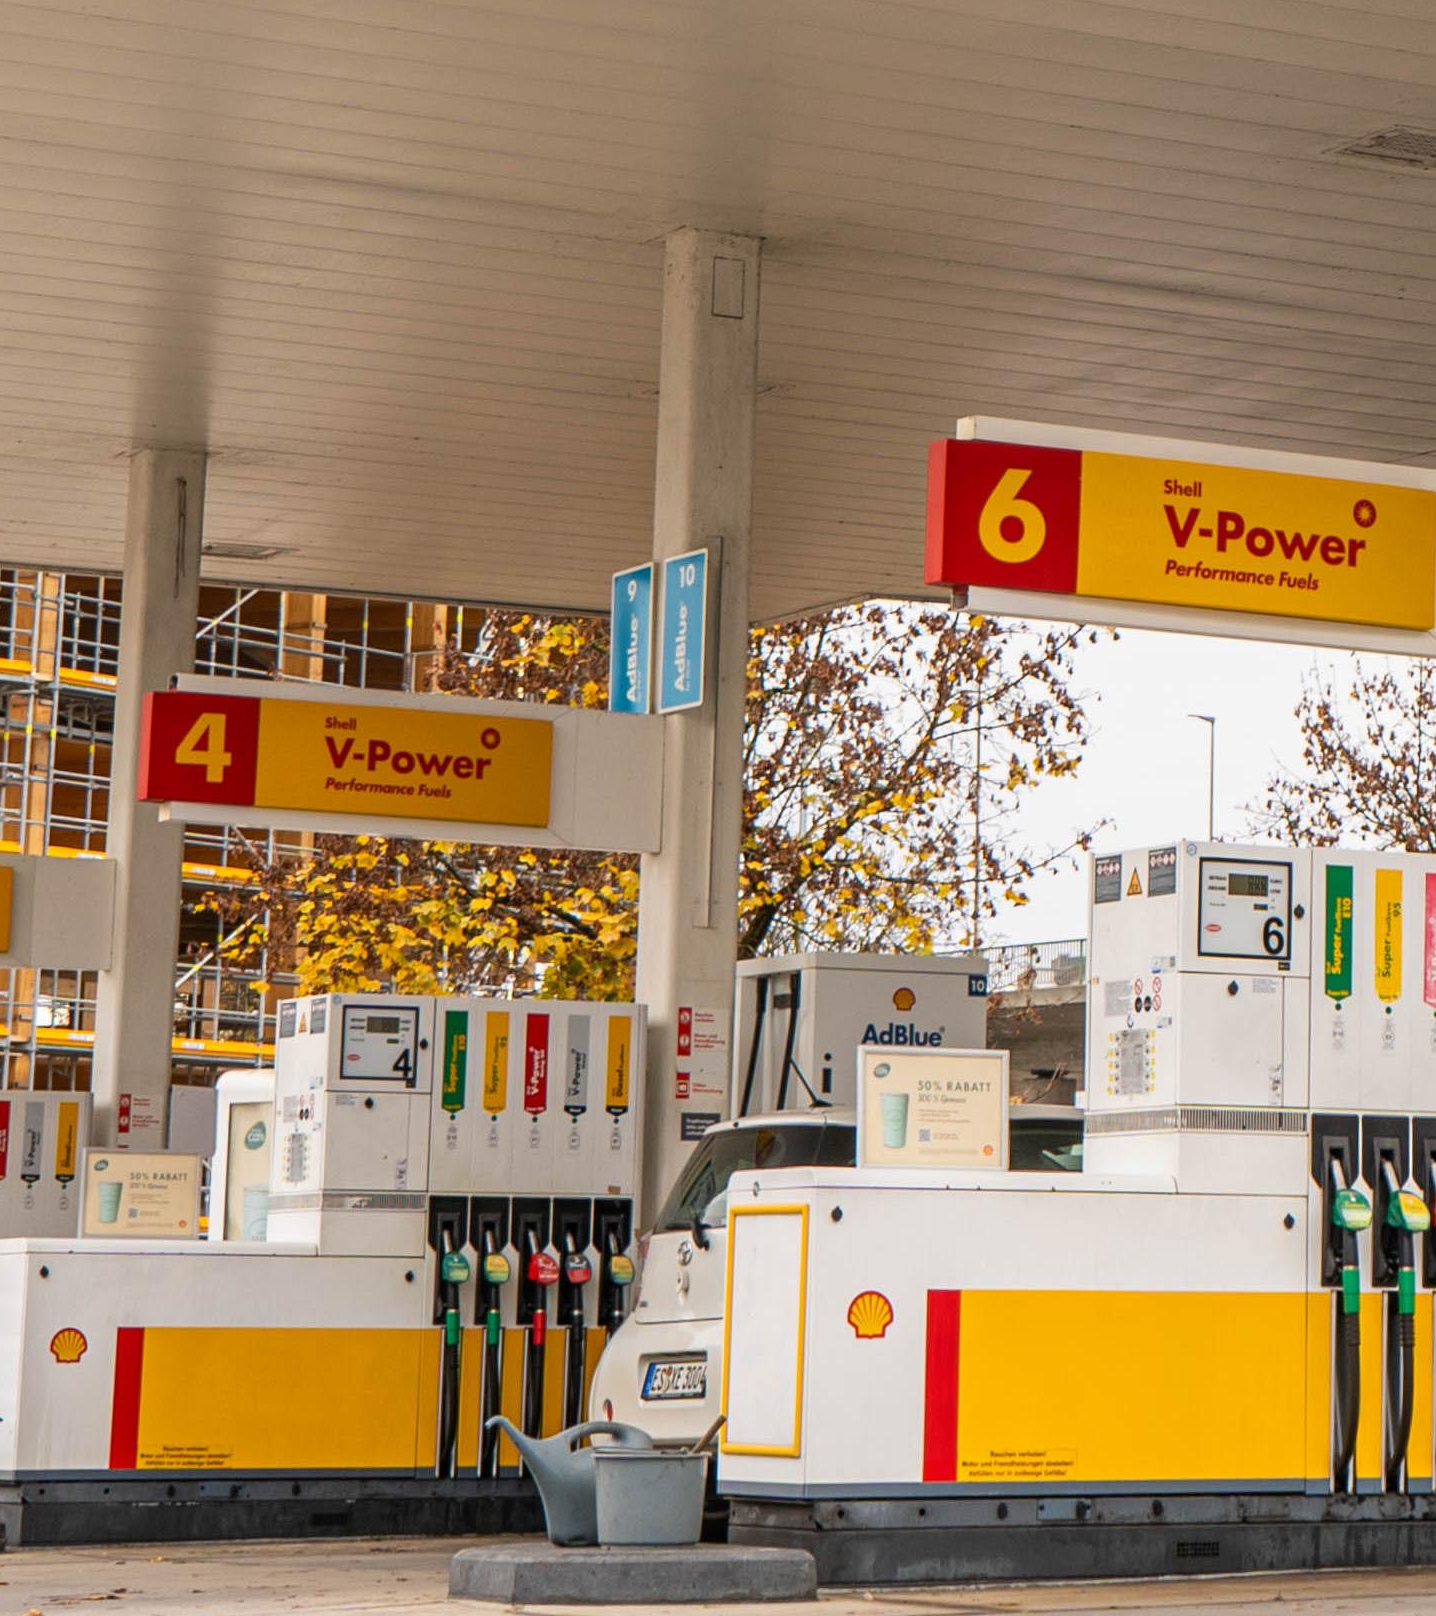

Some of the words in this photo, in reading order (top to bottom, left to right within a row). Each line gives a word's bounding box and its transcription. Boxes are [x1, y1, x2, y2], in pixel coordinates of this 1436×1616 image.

[1163, 479, 1203, 499] Shell
[978, 467, 1047, 565] 6
[1163, 504, 1367, 568] V-Power
[627, 579, 638, 601] 9
[679, 563, 696, 588] 10
[1165, 558, 1275, 587] Performance
[1278, 570, 1320, 592] Fuels
[626, 615, 640, 702] AdBlue
[673, 603, 688, 693] AdBlue
[324, 717, 358, 731] Shell
[174, 712, 233, 784] 4
[324, 736, 492, 781] V-Power
[324, 777, 415, 797] Performance
[418, 784, 452, 799] Fuels
[1262, 916, 1285, 955] 6
[1331, 935, 1344, 974] Super
[1382, 938, 1396, 978] Super
[970, 980, 985, 994] 10
[861, 1021, 943, 1047] AdBlue
[393, 1048, 412, 1081] 4
[946, 1081, 991, 1093] RABATT
